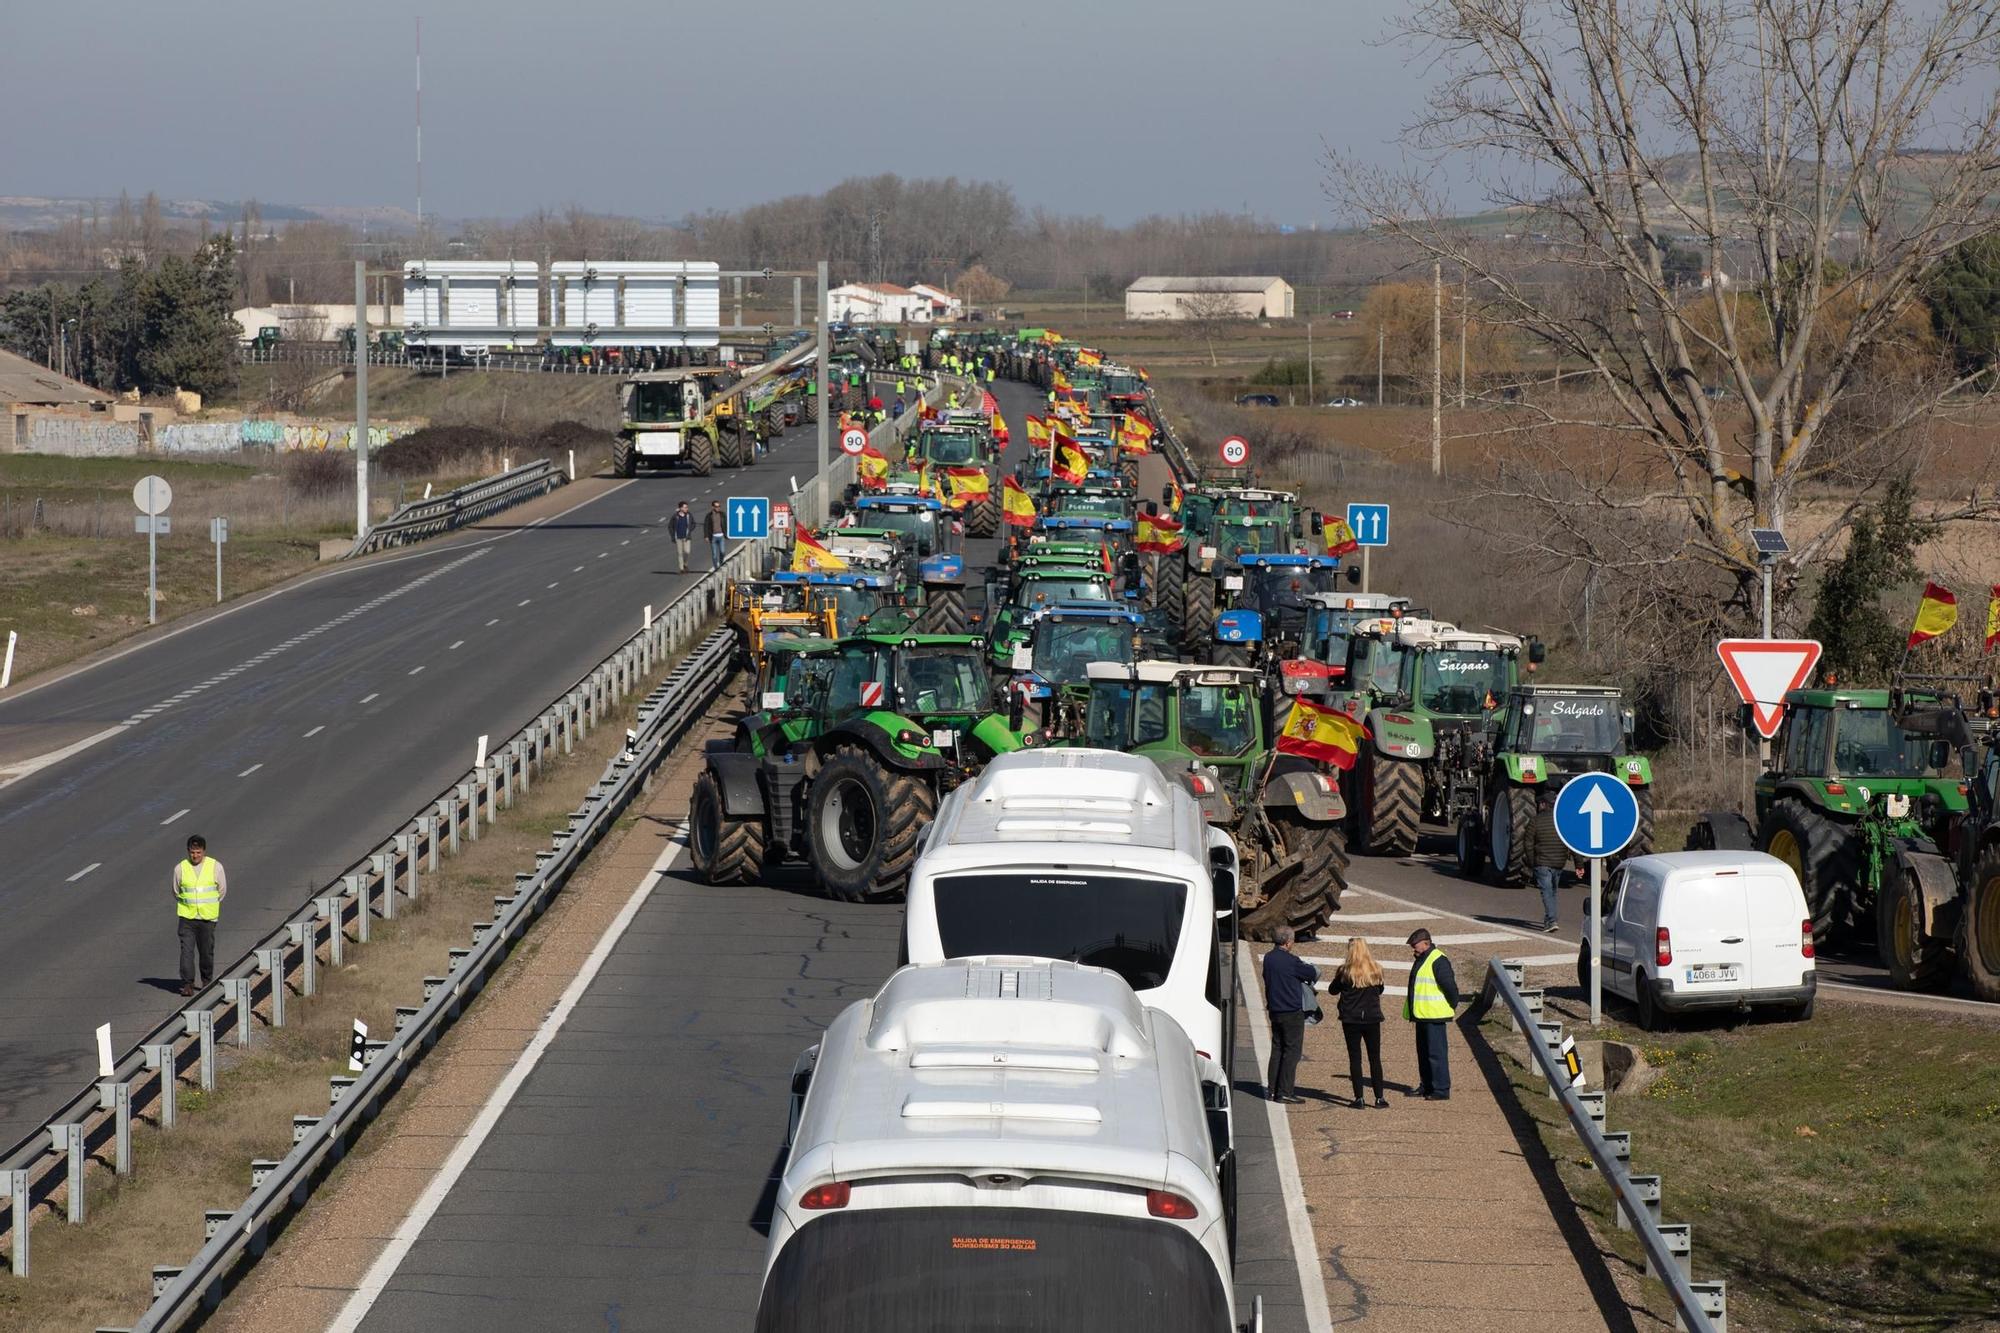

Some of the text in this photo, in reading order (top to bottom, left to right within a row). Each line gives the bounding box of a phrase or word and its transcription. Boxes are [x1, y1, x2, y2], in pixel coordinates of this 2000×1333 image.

[847, 436, 863, 446] 90
[1227, 446, 1243, 456] 90
[1438, 659, 1490, 674] Salgado
[1550, 700, 1604, 719] Salgado
[1408, 745, 1419, 756] 50
[1628, 761, 1640, 772] 40
[1693, 968, 1735, 980] 4068 JVV
